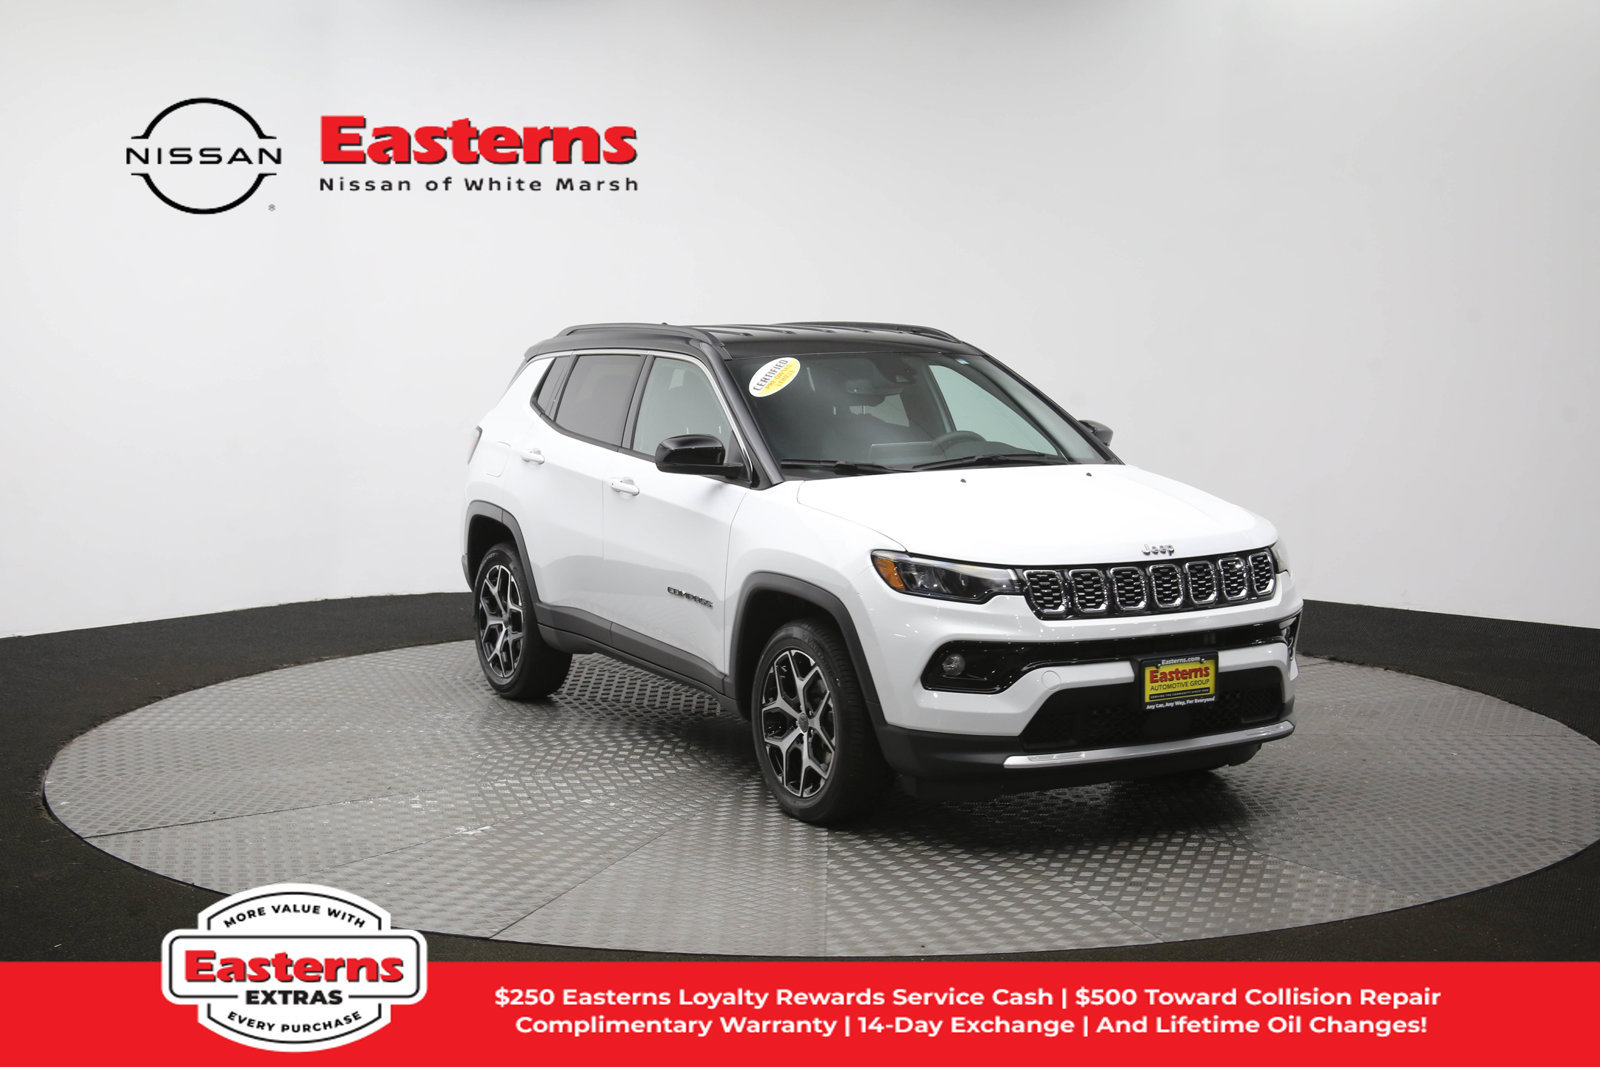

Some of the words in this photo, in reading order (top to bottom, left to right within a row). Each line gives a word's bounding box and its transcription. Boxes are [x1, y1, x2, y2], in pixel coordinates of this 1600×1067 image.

[753, 359, 789, 391] CERTIFIED
[1142, 543, 1175, 556] Jeep
[667, 586, 713, 608] COMPASS
[1162, 657, 1201, 665] Easterns.com
[1150, 666, 1210, 683] Easterns
[1150, 682, 1189, 691] AUTOMOTIVE
[1190, 679, 1210, 687] GROUP
